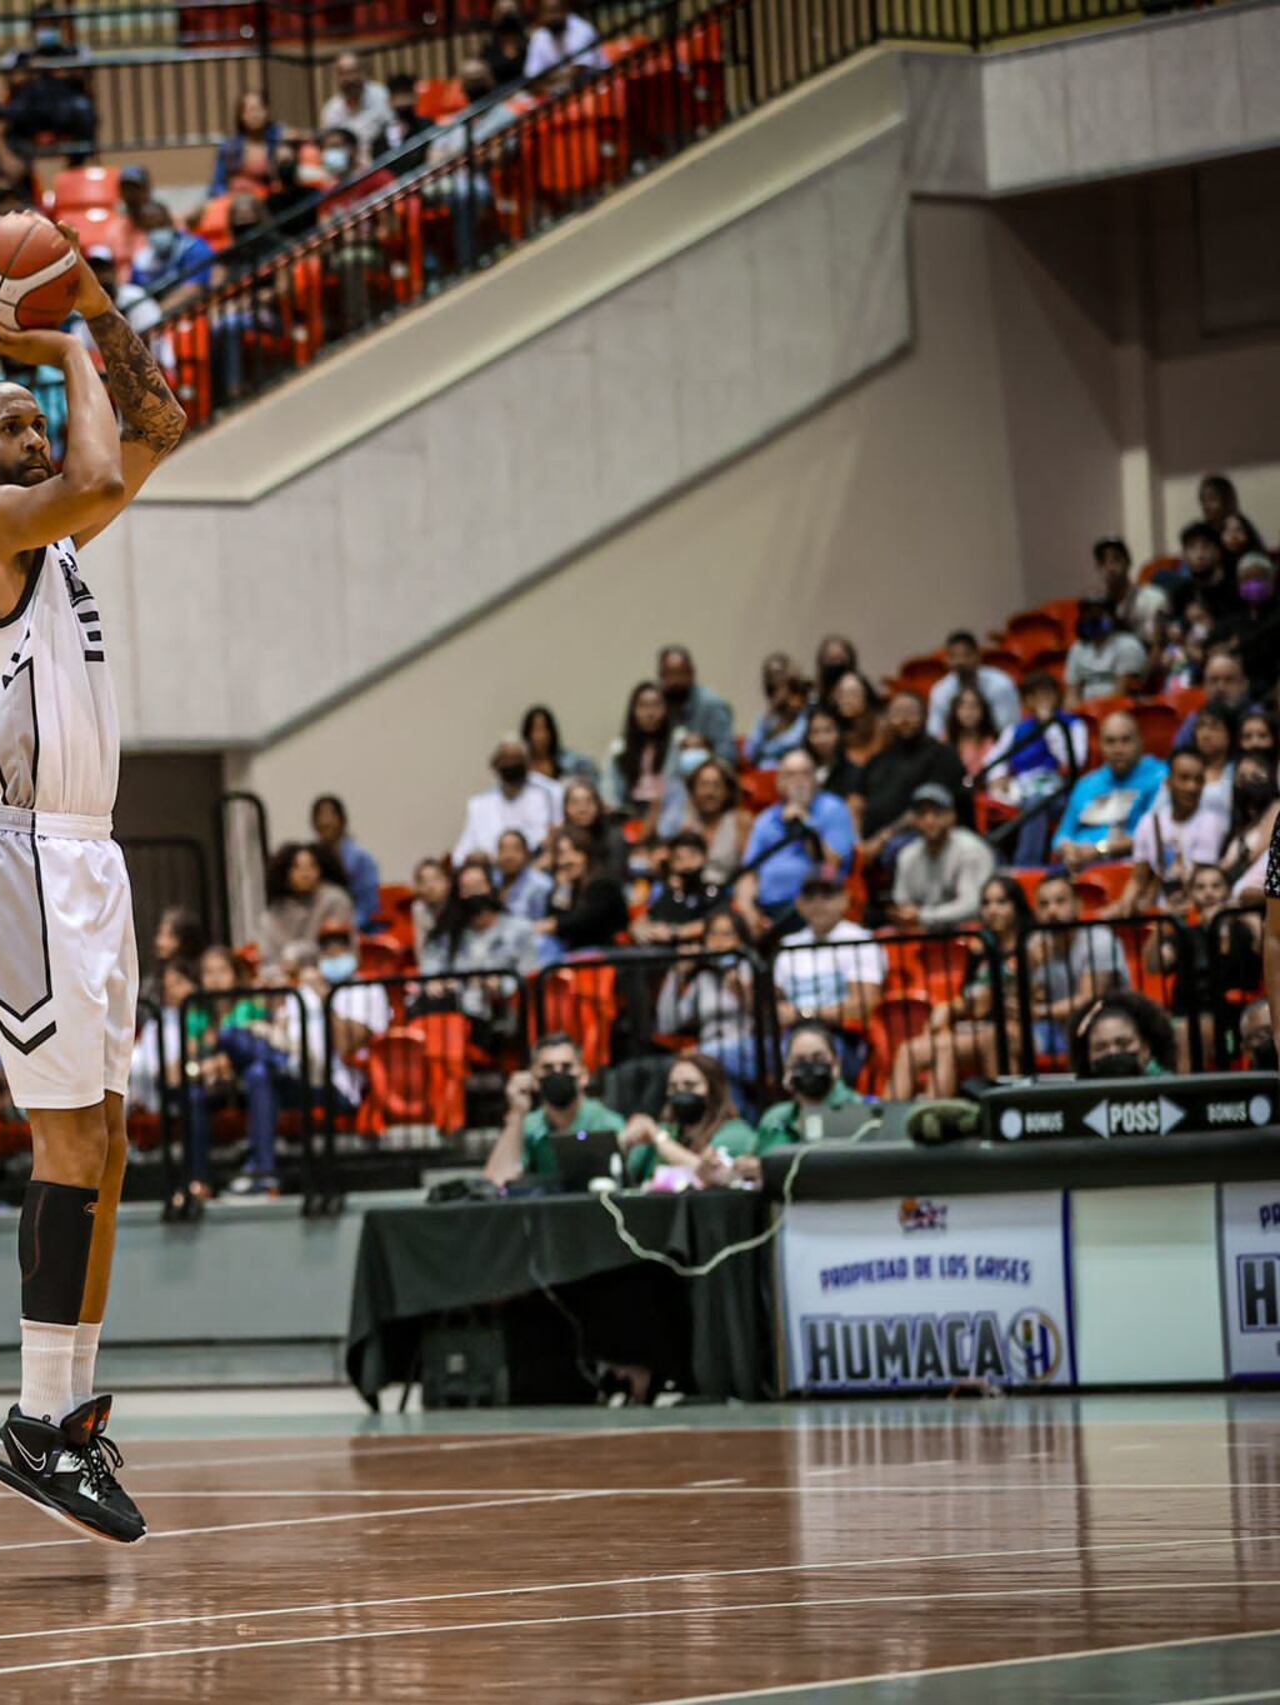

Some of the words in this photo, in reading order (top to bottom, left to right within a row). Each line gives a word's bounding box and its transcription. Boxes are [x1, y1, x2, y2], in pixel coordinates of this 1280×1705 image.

[1110, 1101, 1160, 1133] POSS
[819, 1256, 908, 1290] PROPIEDAD
[913, 1255, 933, 1279] DE
[939, 1255, 968, 1279] LOS
[974, 1255, 1031, 1284] GRISES
